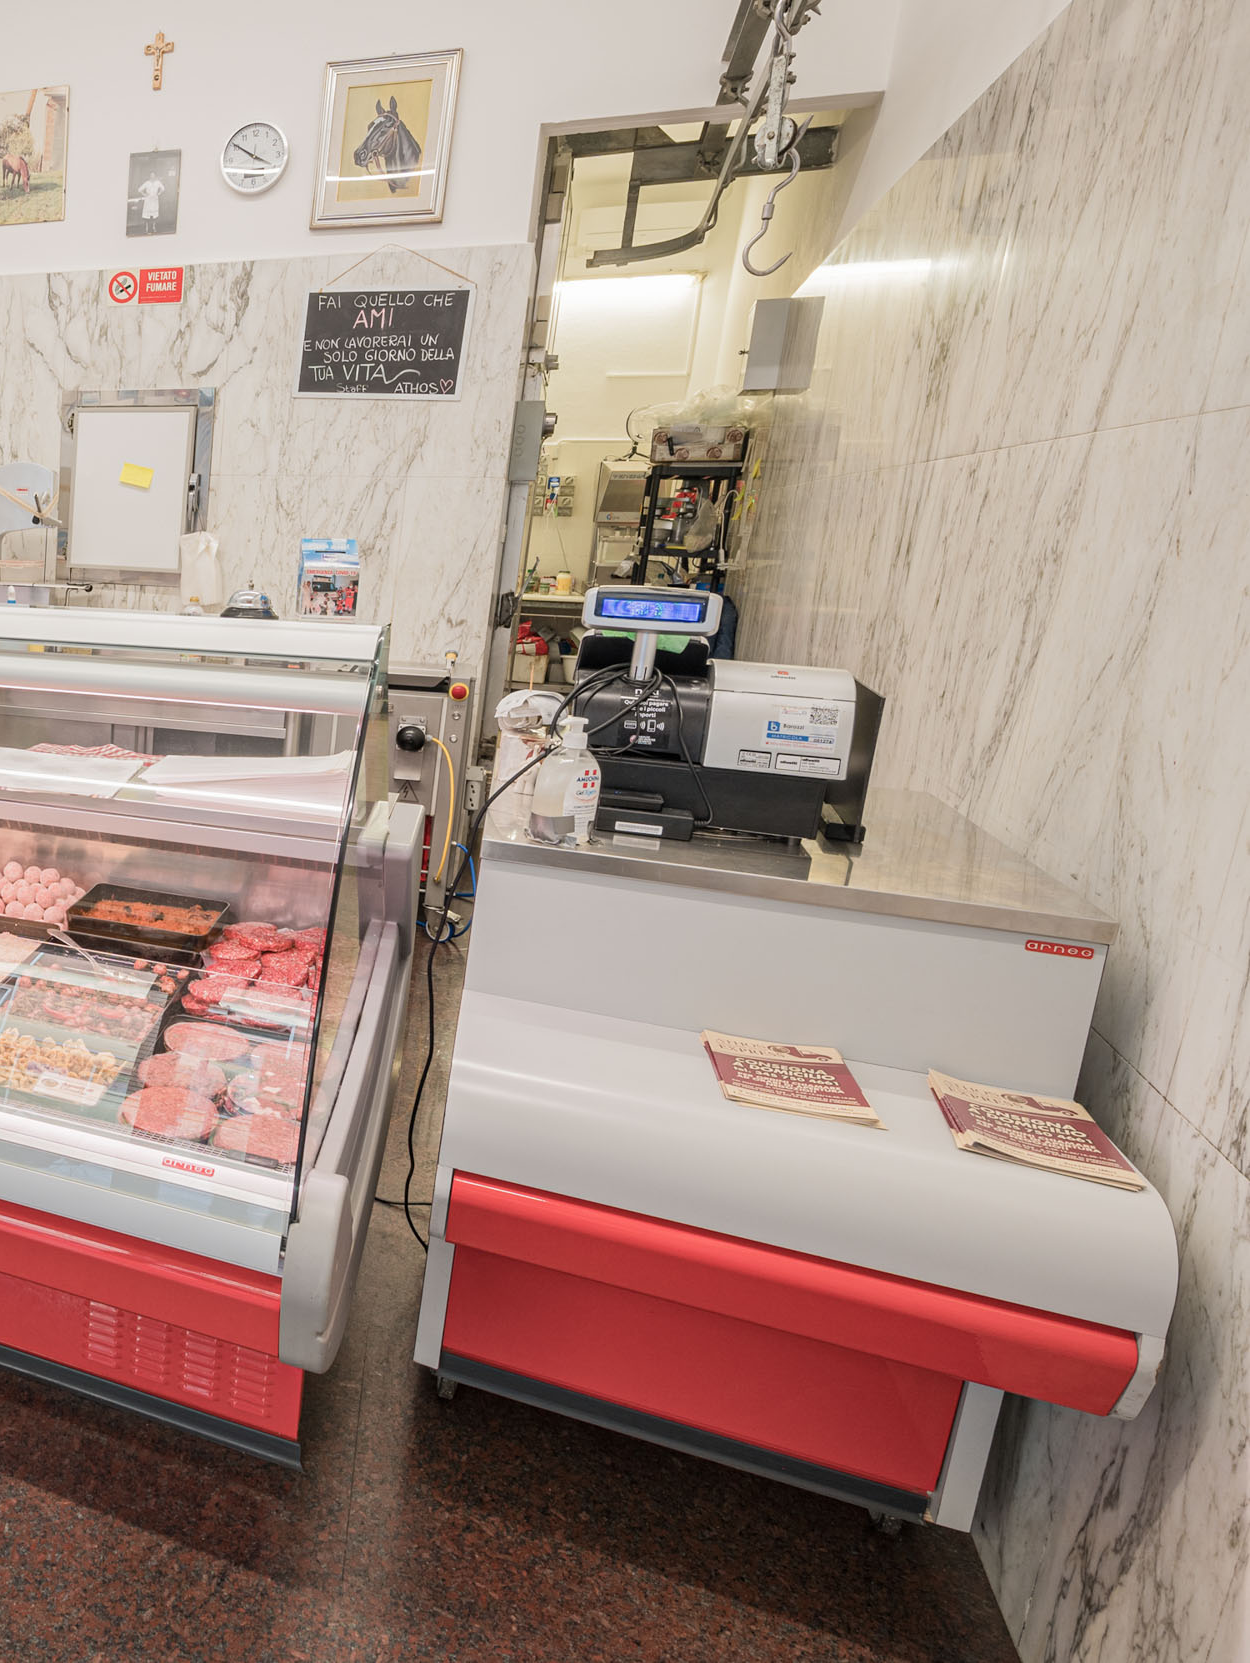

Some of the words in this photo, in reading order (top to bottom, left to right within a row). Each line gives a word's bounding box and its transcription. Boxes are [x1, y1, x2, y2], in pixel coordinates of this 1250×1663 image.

[252, 129, 260, 137] 12
[147, 271, 177, 281] VIETATO
[146, 282, 177, 292] FUMARE
[318, 295, 341, 311] FAI
[353, 293, 415, 308] QUELLO
[423, 292, 456, 307] CHE
[352, 307, 394, 329] AMI
[303, 340, 312, 351] E
[315, 337, 341, 351] NON
[344, 334, 412, 349] LAVORERAI
[420, 333, 440, 346] UN
[323, 351, 358, 364] SOLO
[364, 349, 416, 362] GIORNO
[421, 347, 455, 361] DELLA
[308, 365, 335, 382] TUA
[342, 363, 392, 384] VITA
[336, 383, 369, 393] Staff
[393, 382, 439, 394] ATHOS
[735, 1057, 827, 1076] CONSEGNA
[749, 1064, 836, 1081] DOMICILIO
[967, 1102, 1078, 1131] CONSEGNA
[986, 1113, 1089, 1138] DOMICILIO
